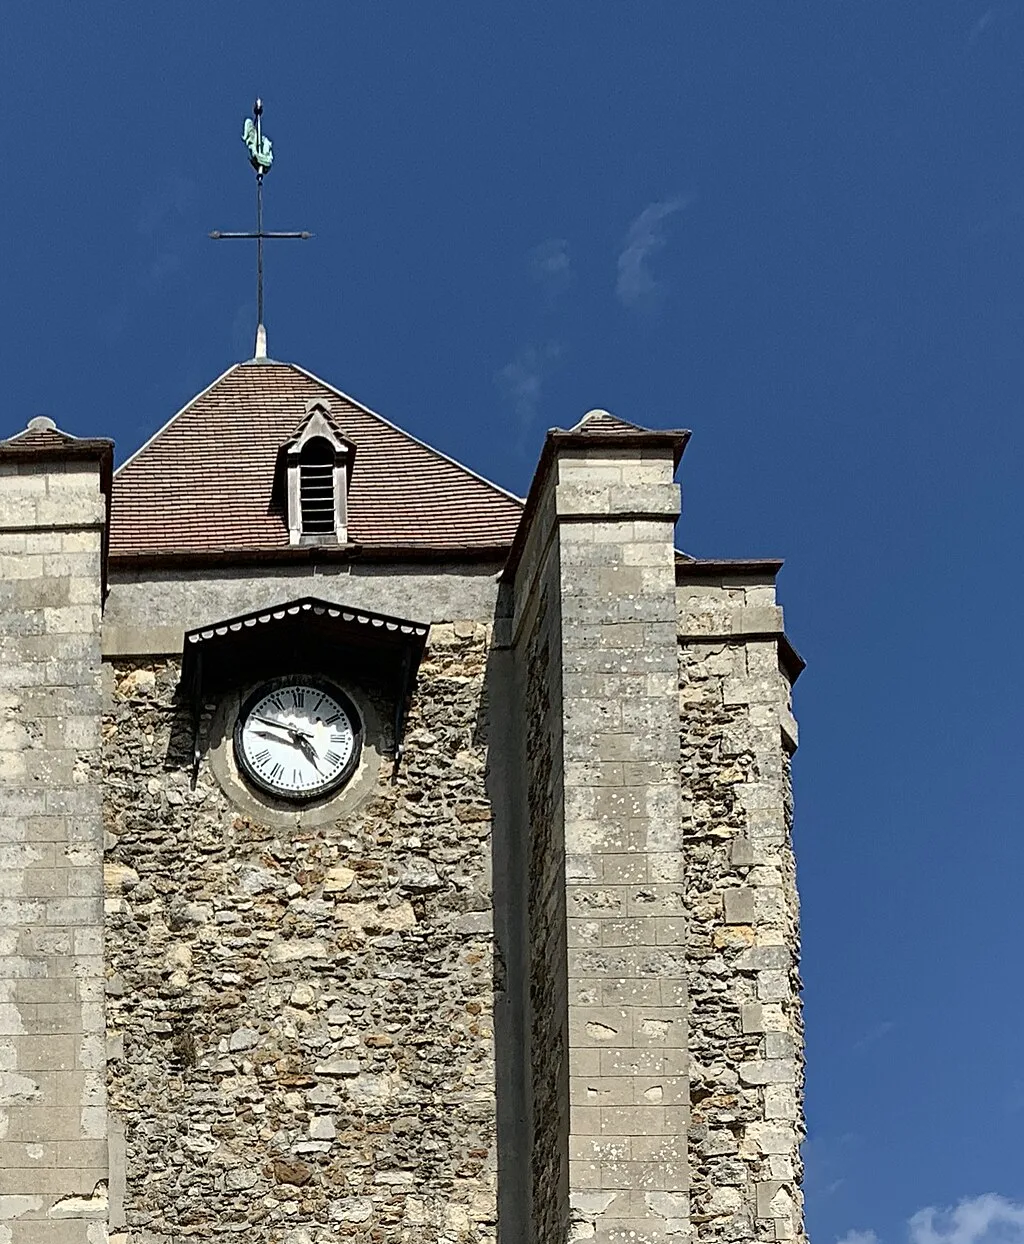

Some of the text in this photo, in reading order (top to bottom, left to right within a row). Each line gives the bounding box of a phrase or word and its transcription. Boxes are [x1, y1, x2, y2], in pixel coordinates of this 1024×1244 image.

[292, 692, 304, 708] XII
[313, 698, 323, 712] I
[325, 713, 341, 725] II
[330, 734, 345, 743] III
